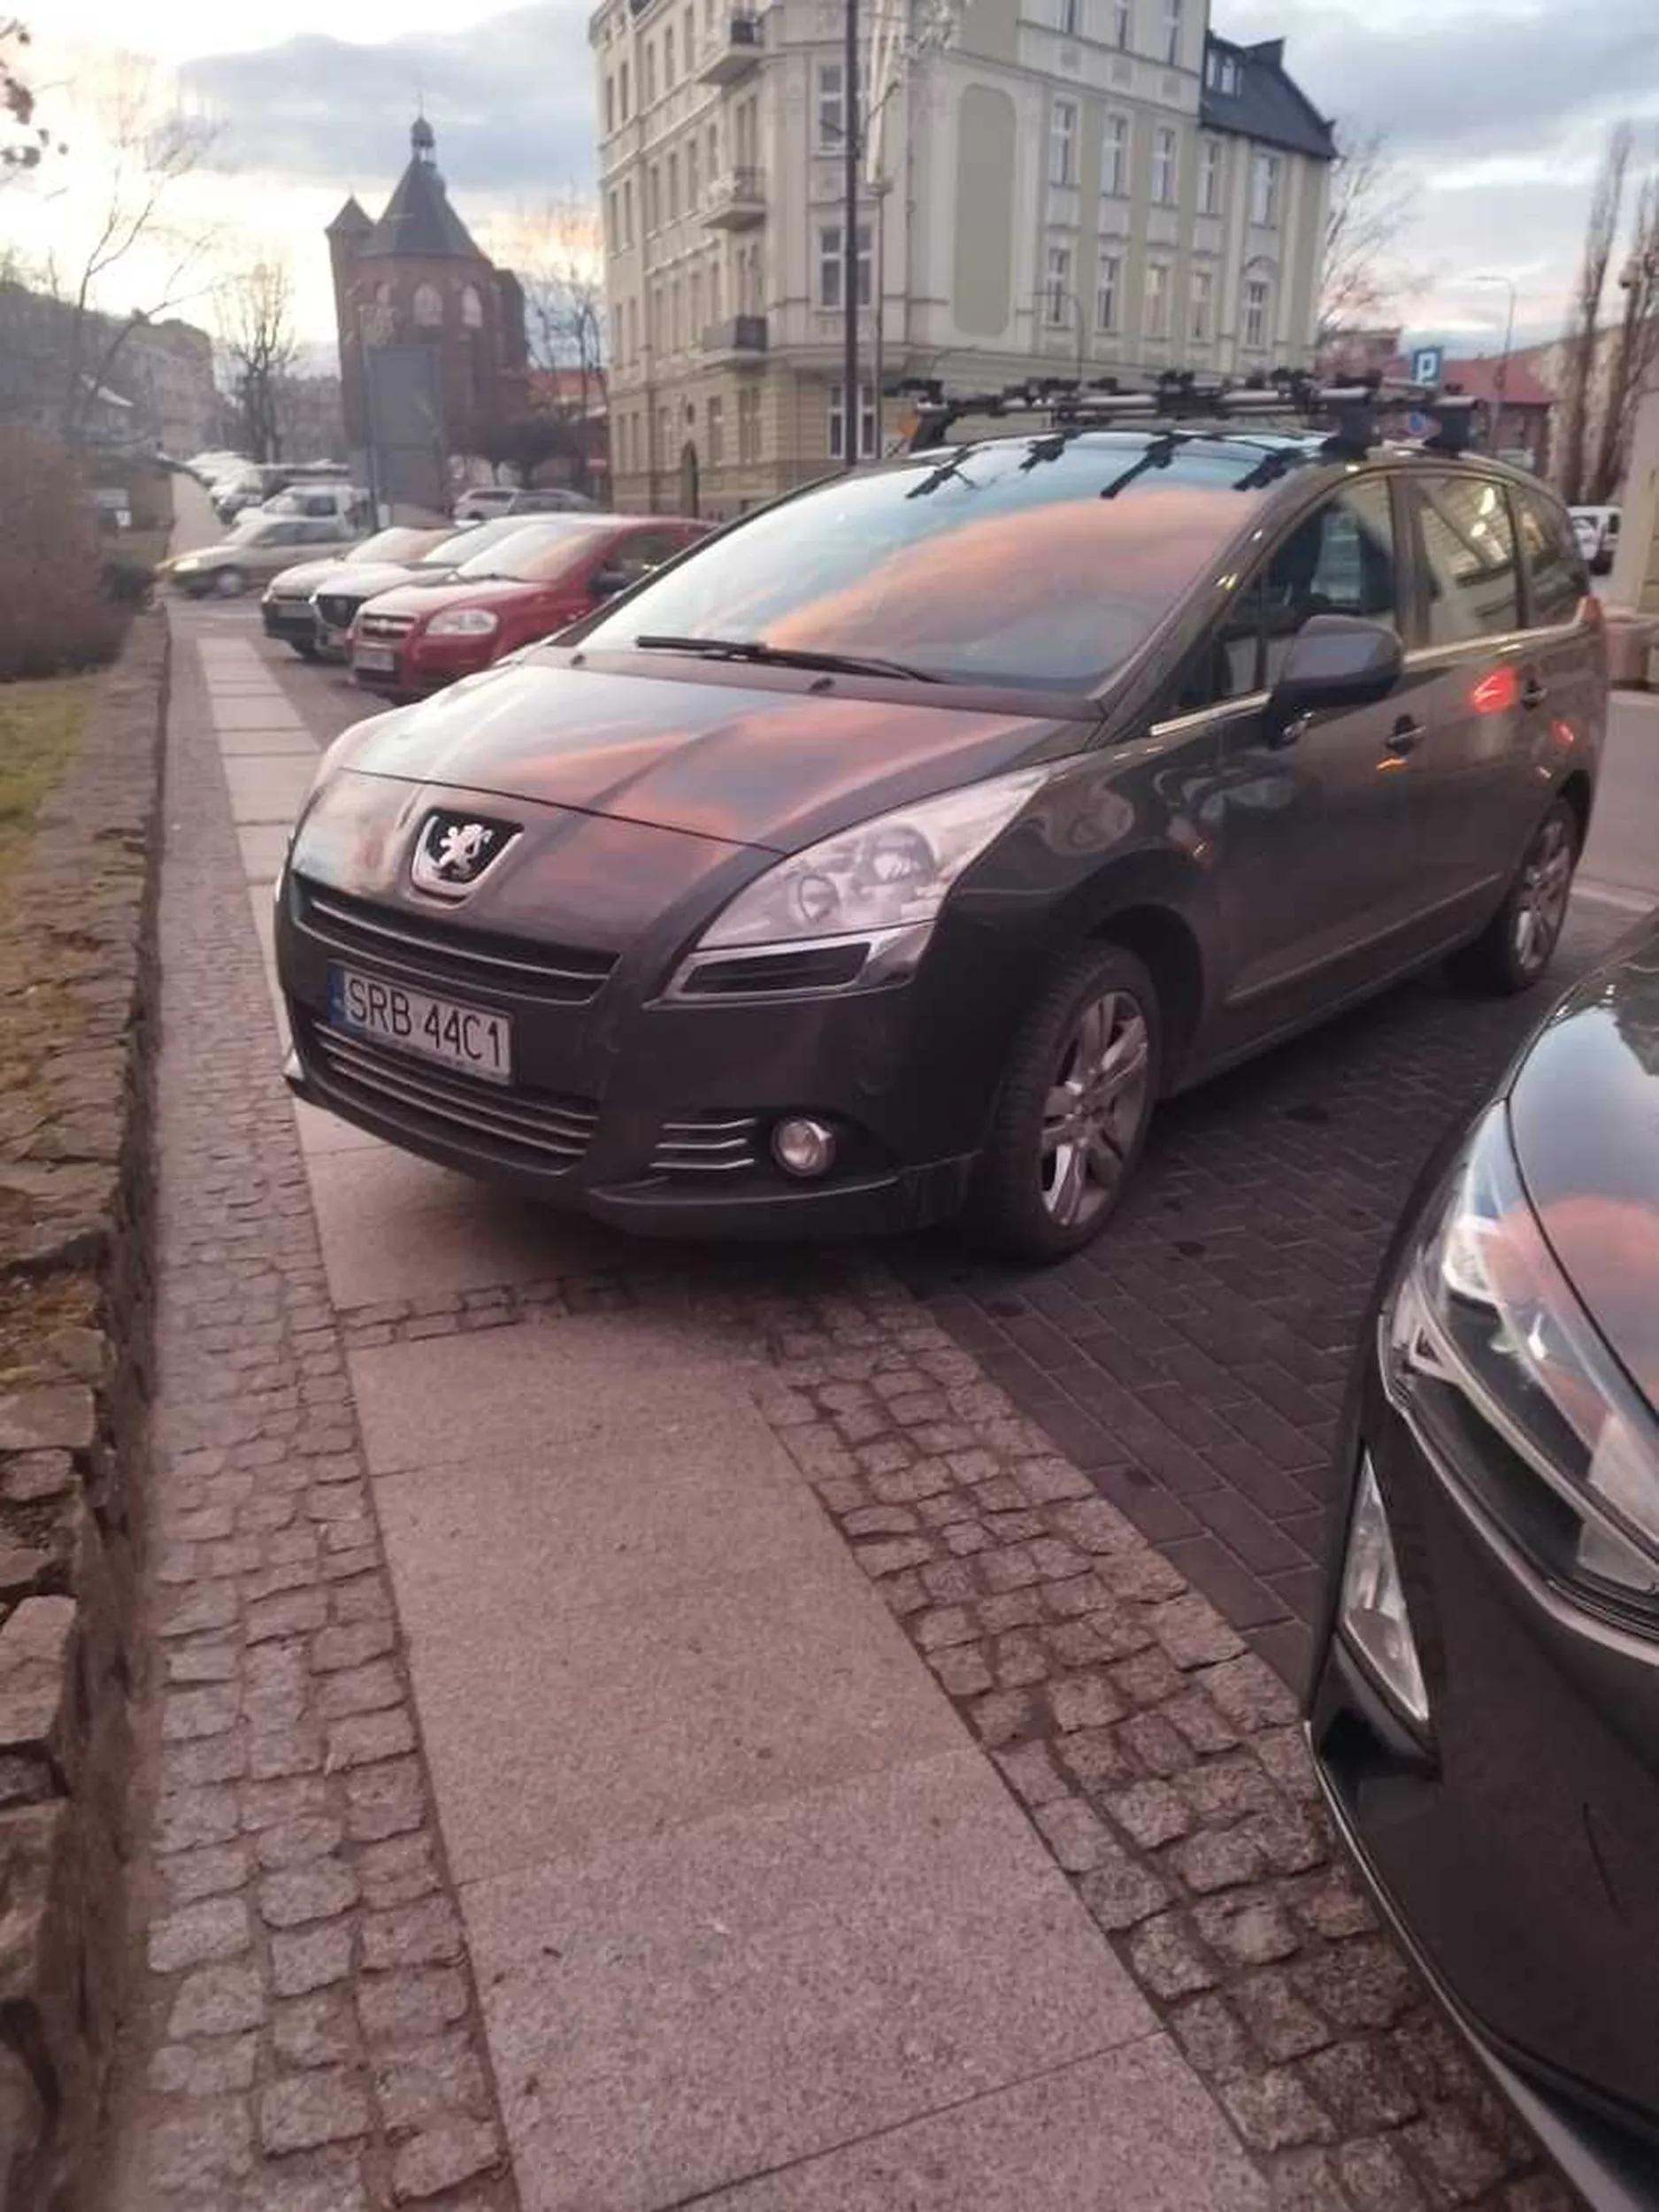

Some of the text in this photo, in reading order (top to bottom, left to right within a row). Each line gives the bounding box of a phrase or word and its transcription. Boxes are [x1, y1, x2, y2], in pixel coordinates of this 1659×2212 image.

[1417, 352, 1437, 384] P
[349, 979, 500, 1067] SRB 44C1
